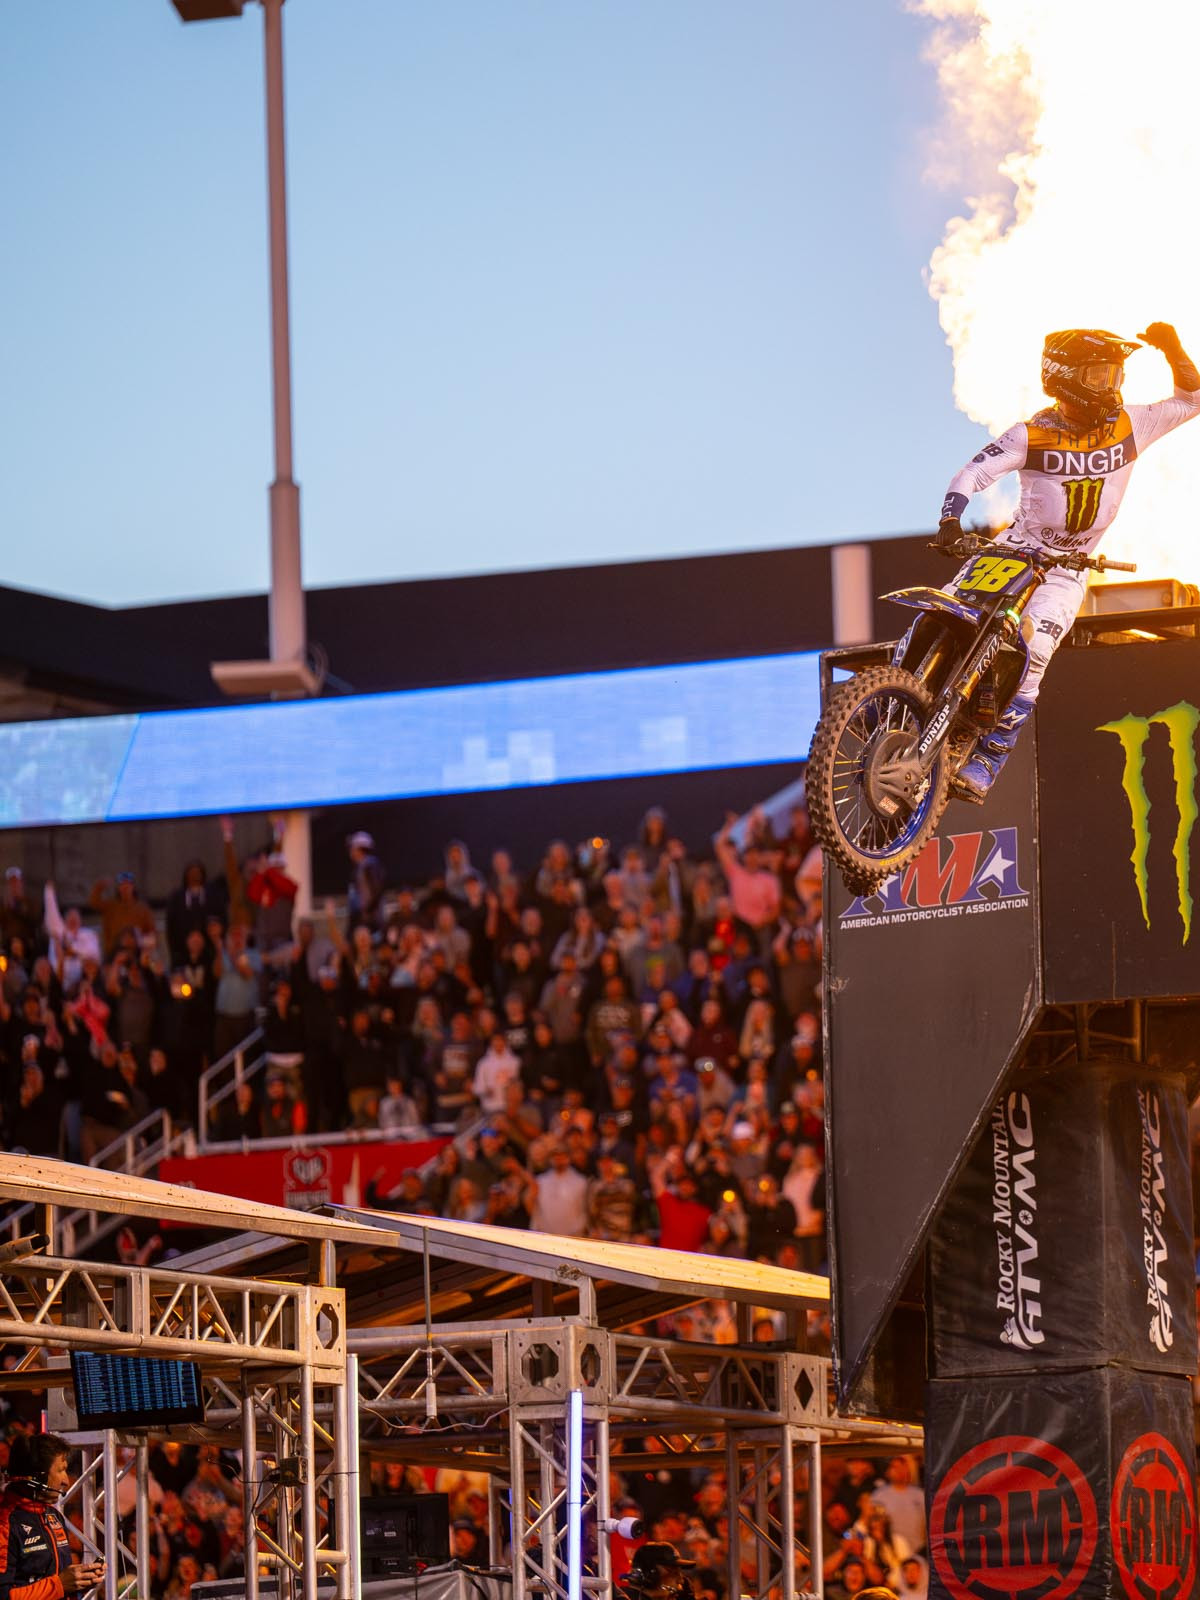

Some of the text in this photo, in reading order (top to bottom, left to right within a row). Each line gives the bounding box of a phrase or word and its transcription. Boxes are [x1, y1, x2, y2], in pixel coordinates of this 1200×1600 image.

[957, 556, 1028, 593] 38
[1036, 619, 1064, 641] 38
[919, 704, 950, 754] DUNLOP
[840, 898, 1029, 930] AMERICAN MOTORCYCLIST ASSOCIATION
[996, 1229, 1016, 1313] ROCKY
[1144, 1226, 1159, 1307] ROCKY
